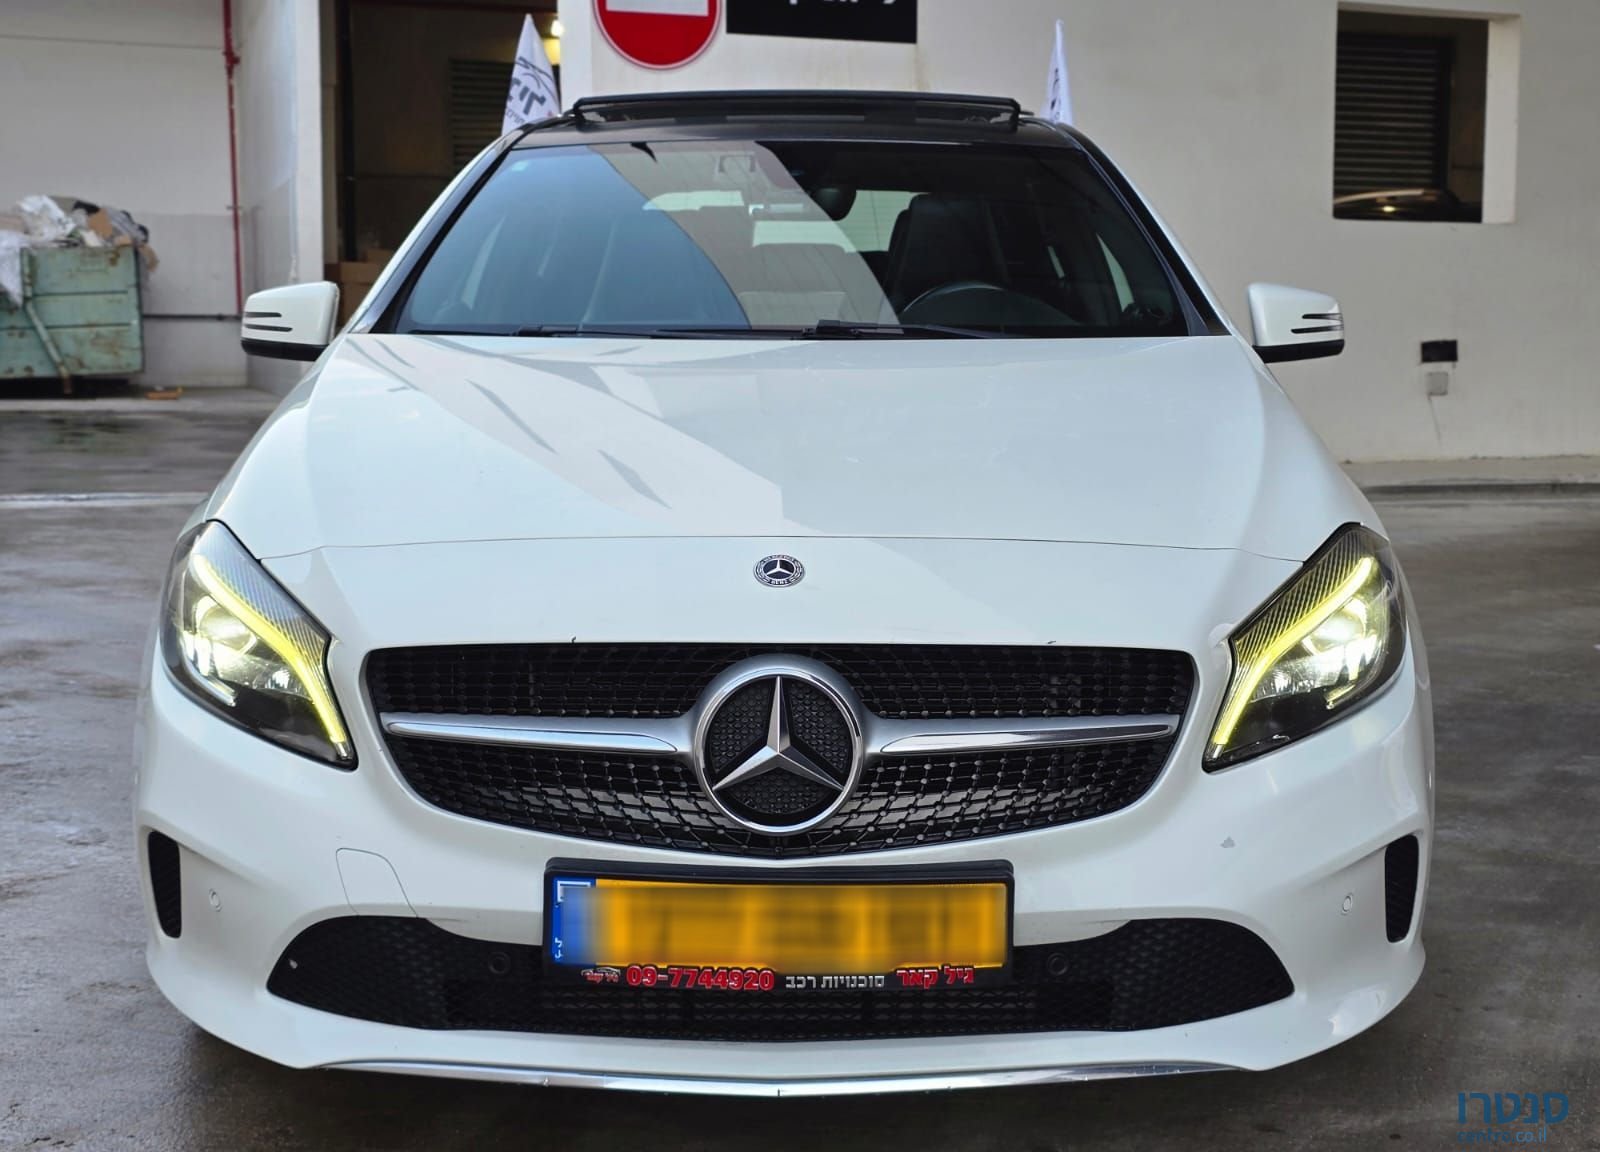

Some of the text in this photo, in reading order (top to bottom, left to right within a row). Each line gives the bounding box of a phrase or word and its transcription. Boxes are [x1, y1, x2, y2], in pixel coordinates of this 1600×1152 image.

[626, 965, 975, 991] גיל קאר סוכנויות רכב 09-7744920
